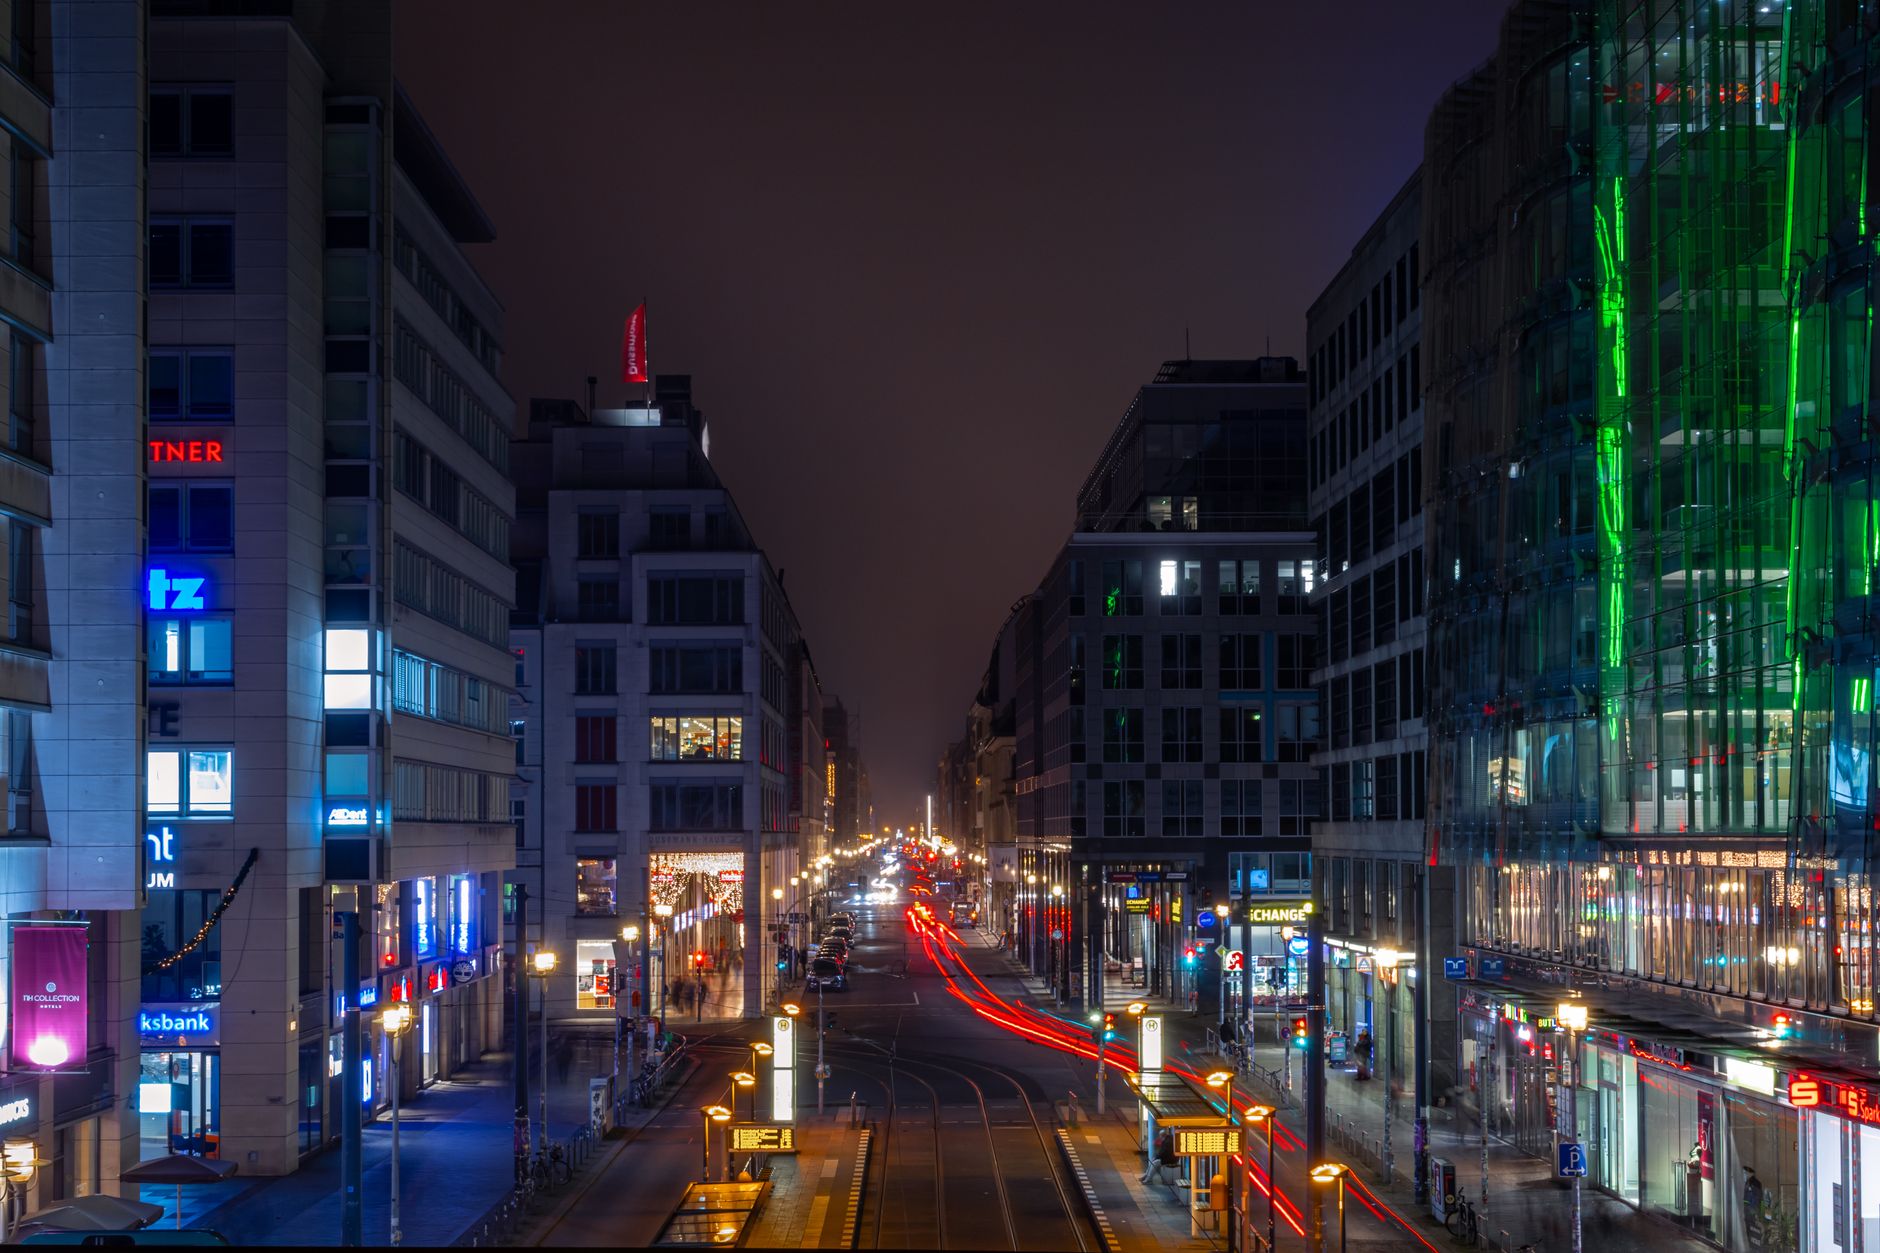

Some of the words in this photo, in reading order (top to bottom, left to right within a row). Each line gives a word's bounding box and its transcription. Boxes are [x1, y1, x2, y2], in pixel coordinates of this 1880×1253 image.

[150, 441, 223, 462] TNER
[141, 1013, 210, 1031] ksbank
[1570, 1152, 1580, 1168] P
